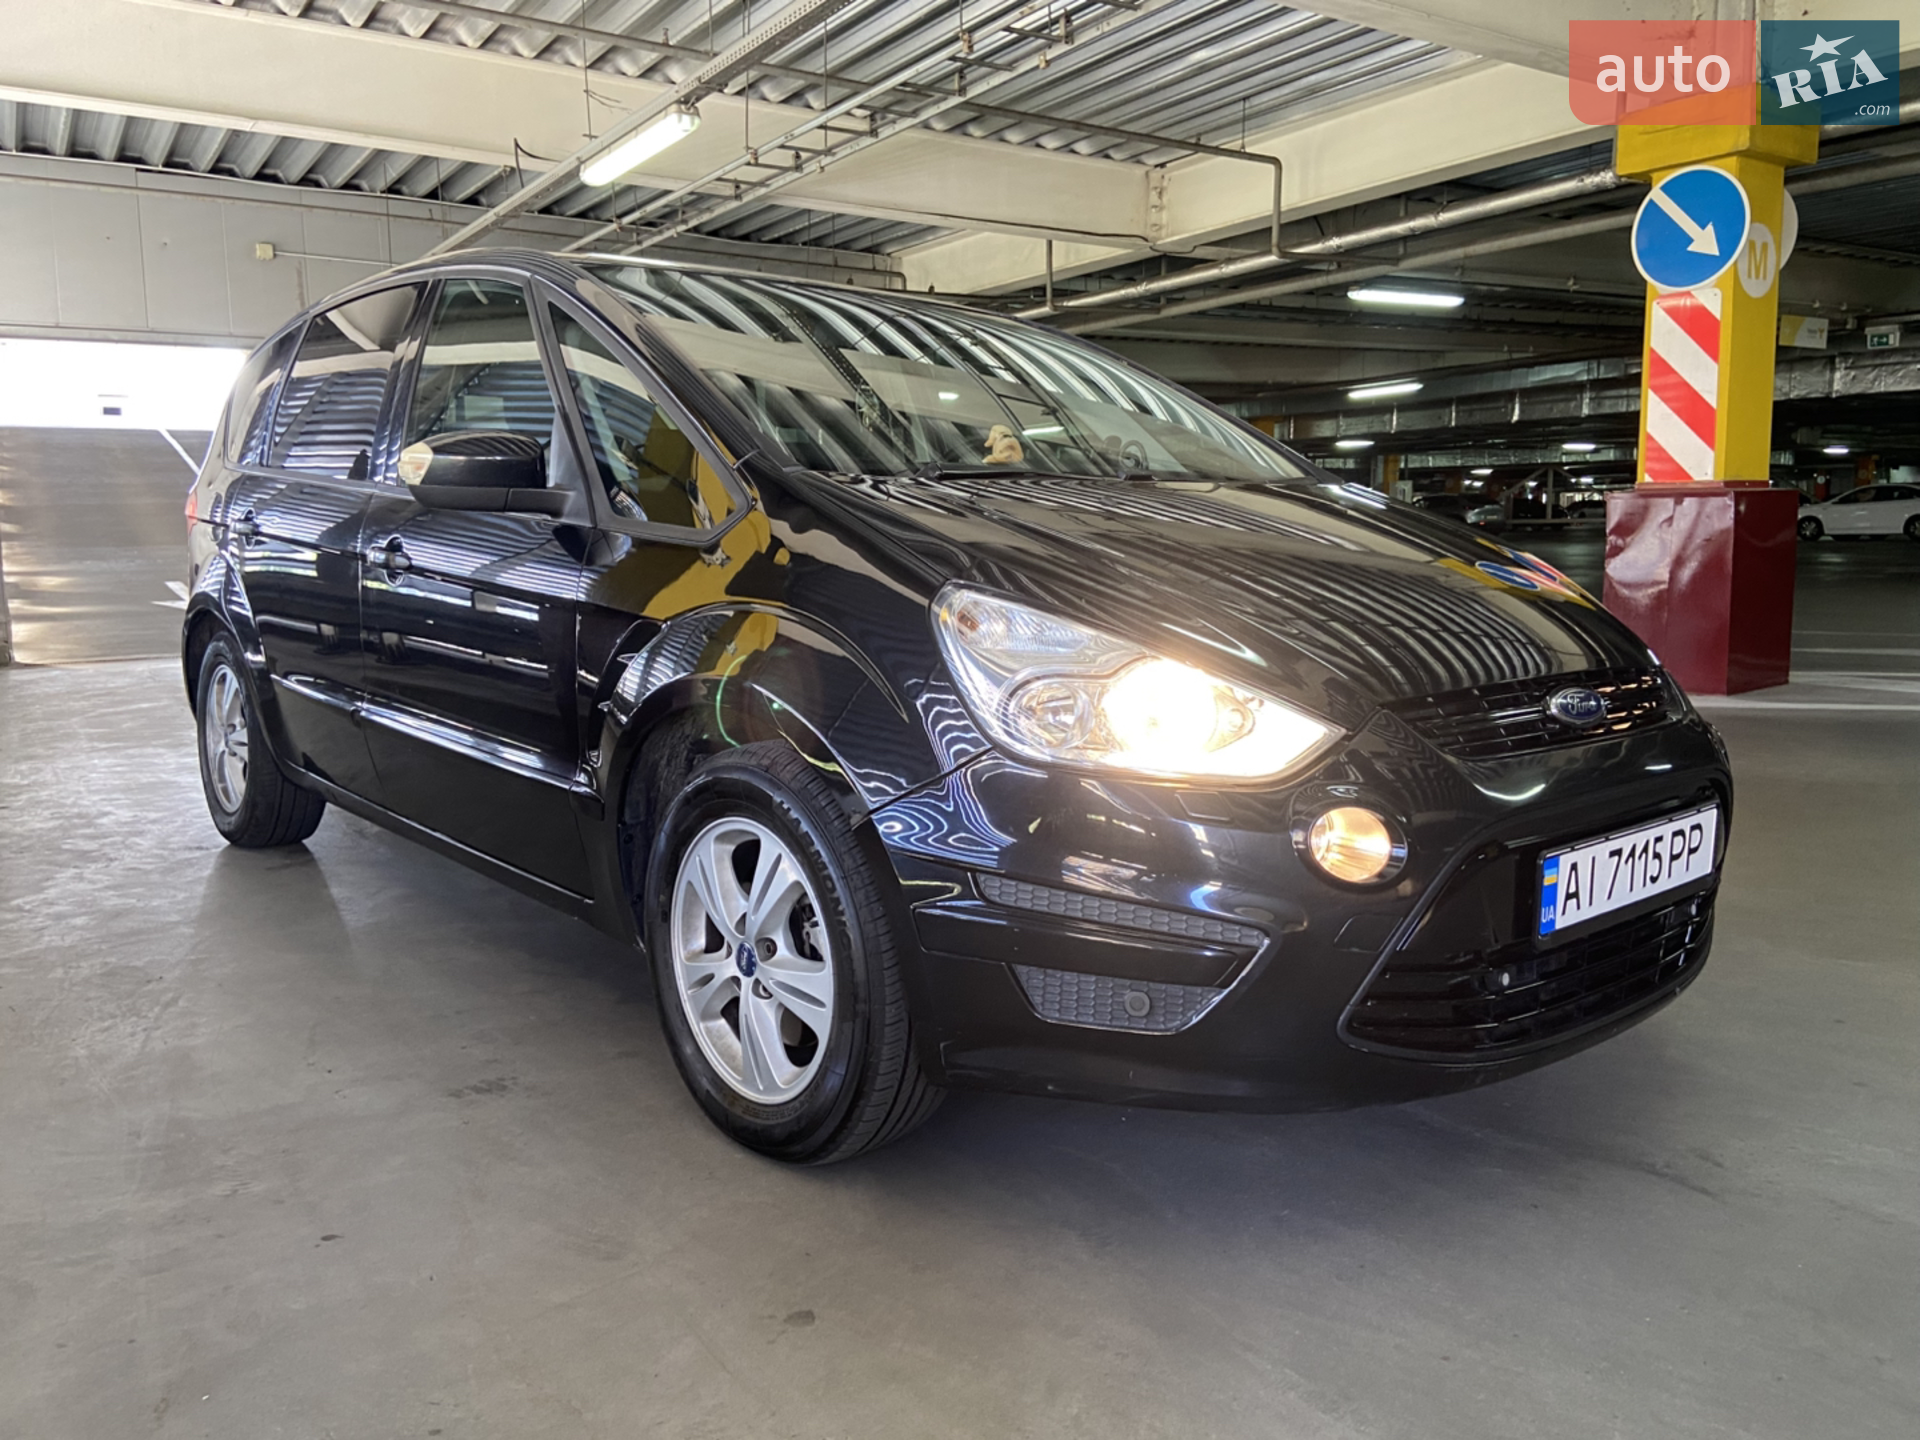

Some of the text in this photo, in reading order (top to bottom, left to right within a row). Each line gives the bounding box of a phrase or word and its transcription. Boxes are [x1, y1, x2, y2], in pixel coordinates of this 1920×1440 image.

[1747, 239, 1769, 281] M
[1566, 692, 1598, 715] Ford
[1561, 856, 1596, 916] AI
[1541, 904, 1555, 923] UA
